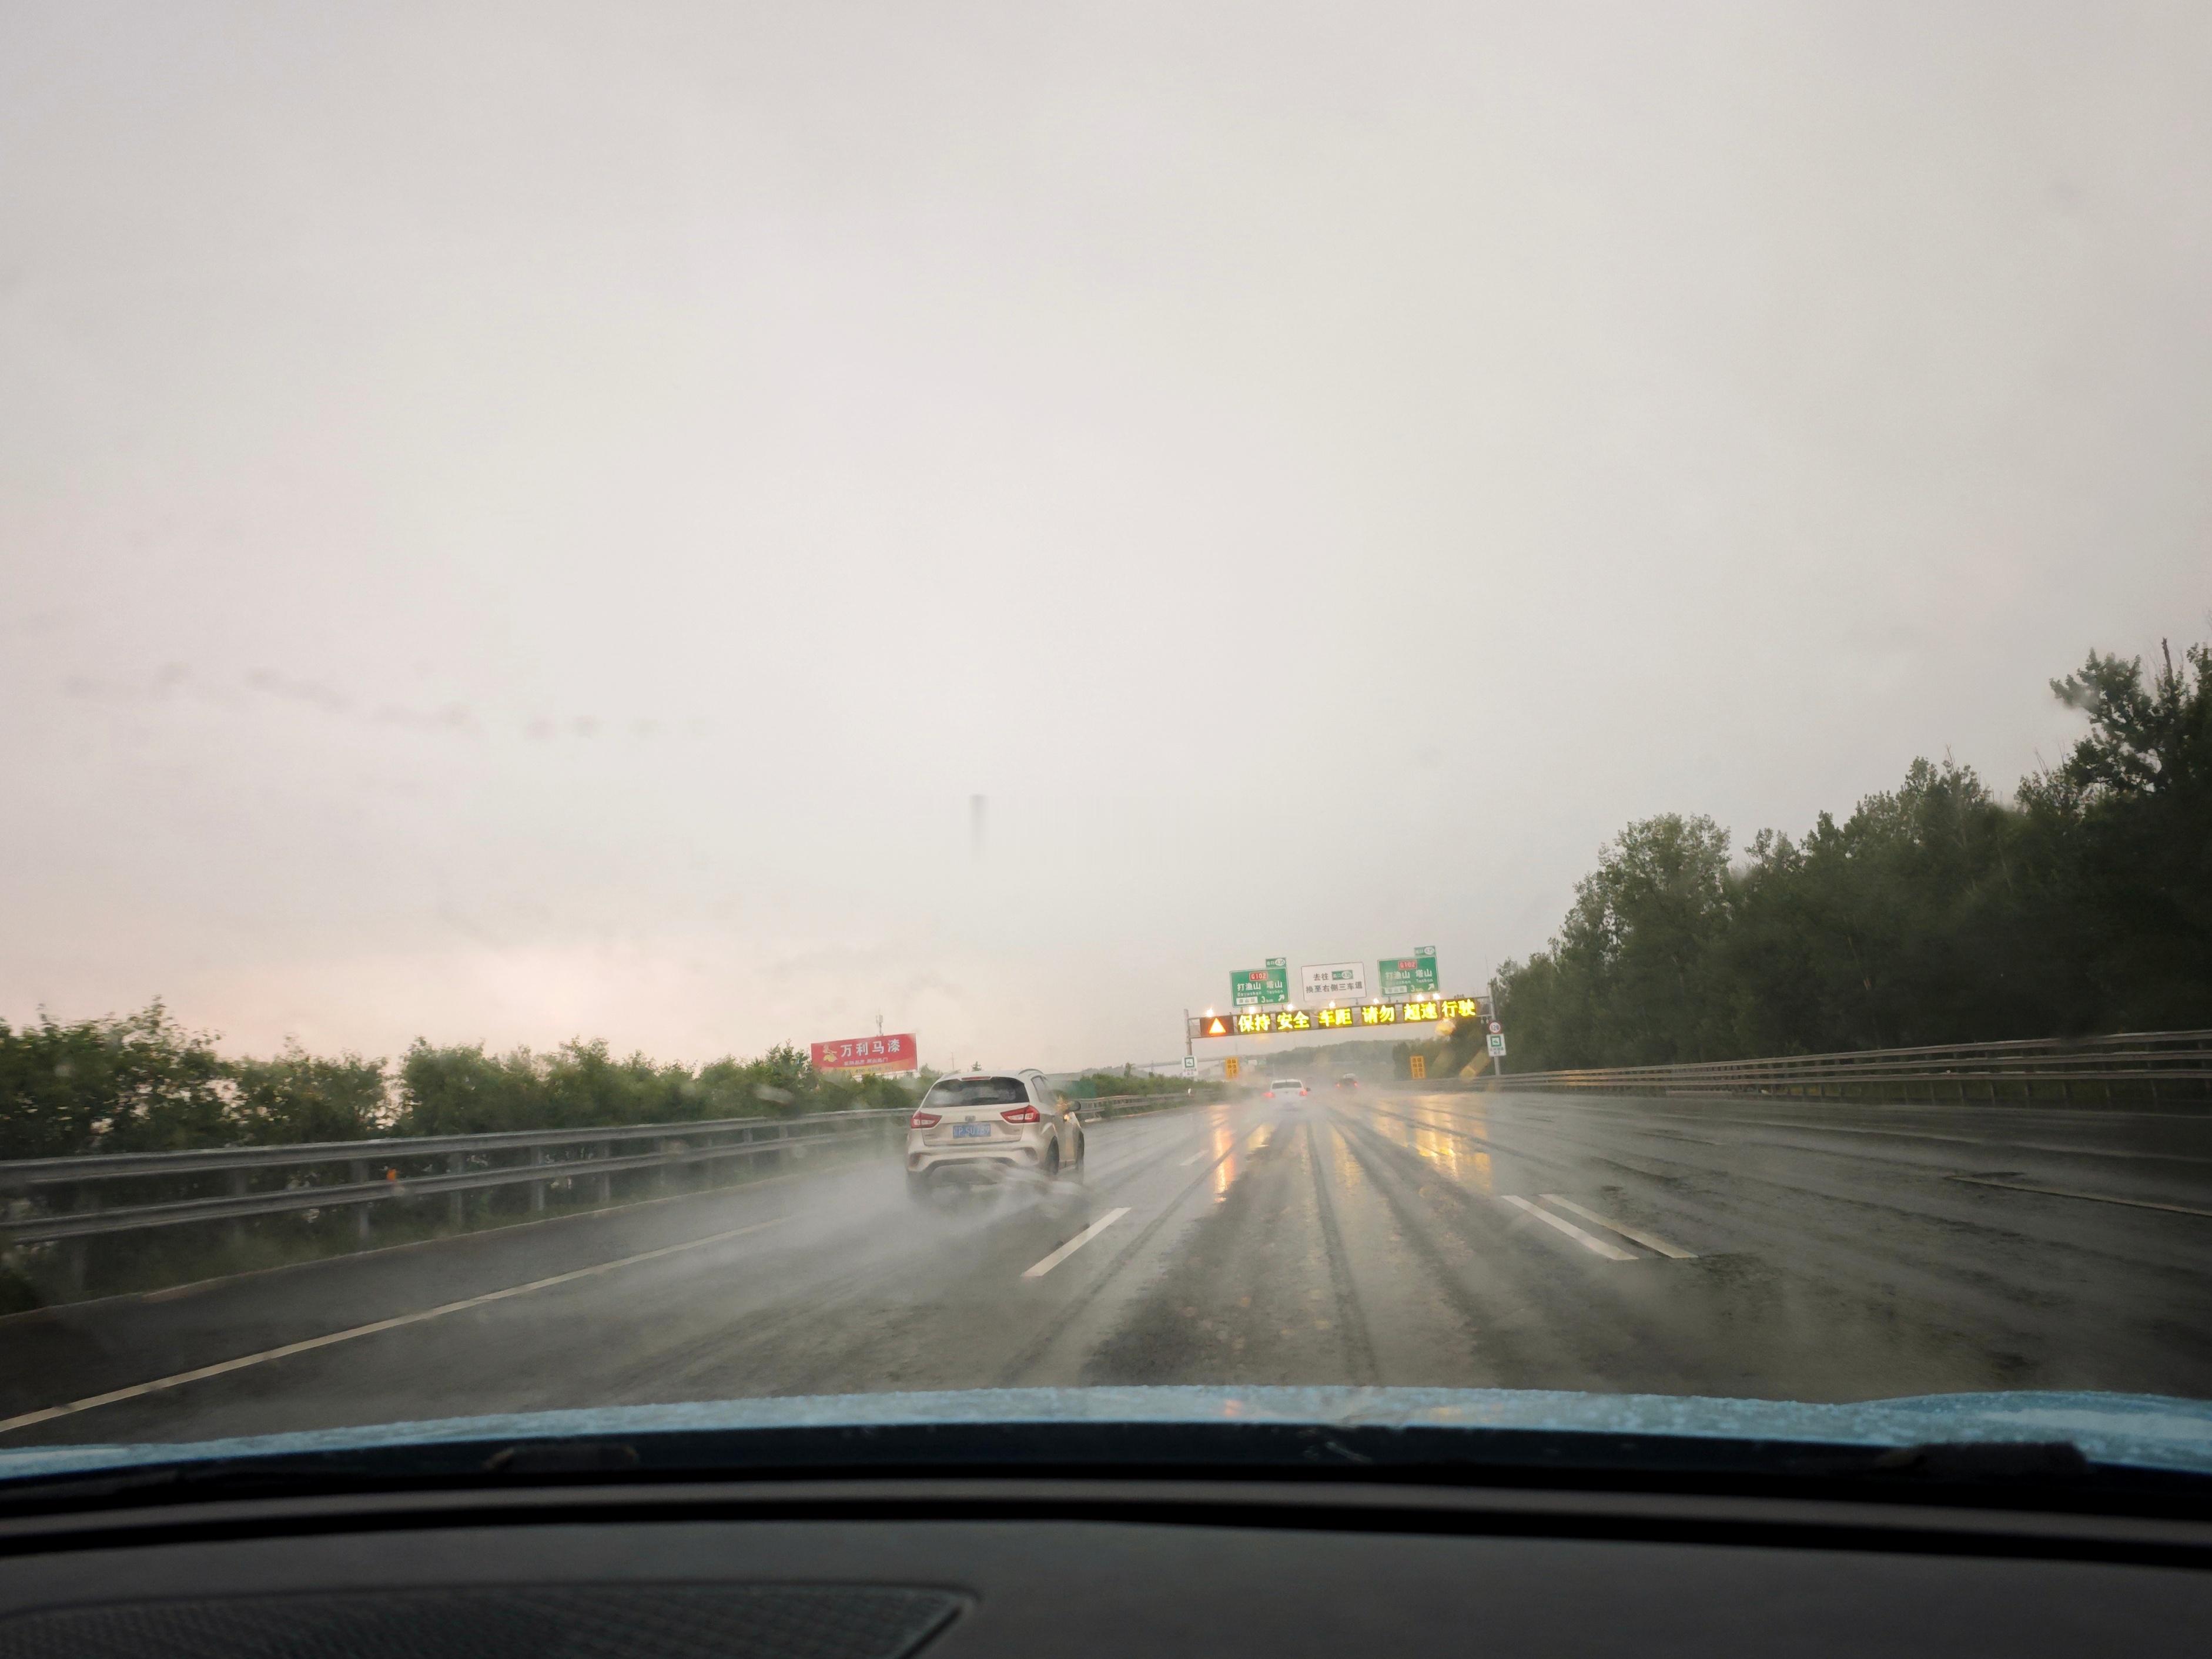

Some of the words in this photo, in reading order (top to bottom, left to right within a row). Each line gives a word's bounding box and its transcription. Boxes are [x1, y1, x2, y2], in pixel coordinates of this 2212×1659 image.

[1313, 973, 1329, 981] 去往
[1415, 968, 1433, 978] 塔山
[1237, 981, 1261, 991] 打渔山
[1306, 981, 1363, 993] 换至右侧三车道
[1238, 1014, 1270, 1033] 保持
[1277, 1011, 1310, 1030] 安全
[1319, 1008, 1353, 1027] 车距
[1362, 1004, 1395, 1024] 请勿
[1404, 1002, 1438, 1021] 超速
[1441, 998, 1476, 1018] 行驶
[840, 1038, 901, 1058] 万利马漆
